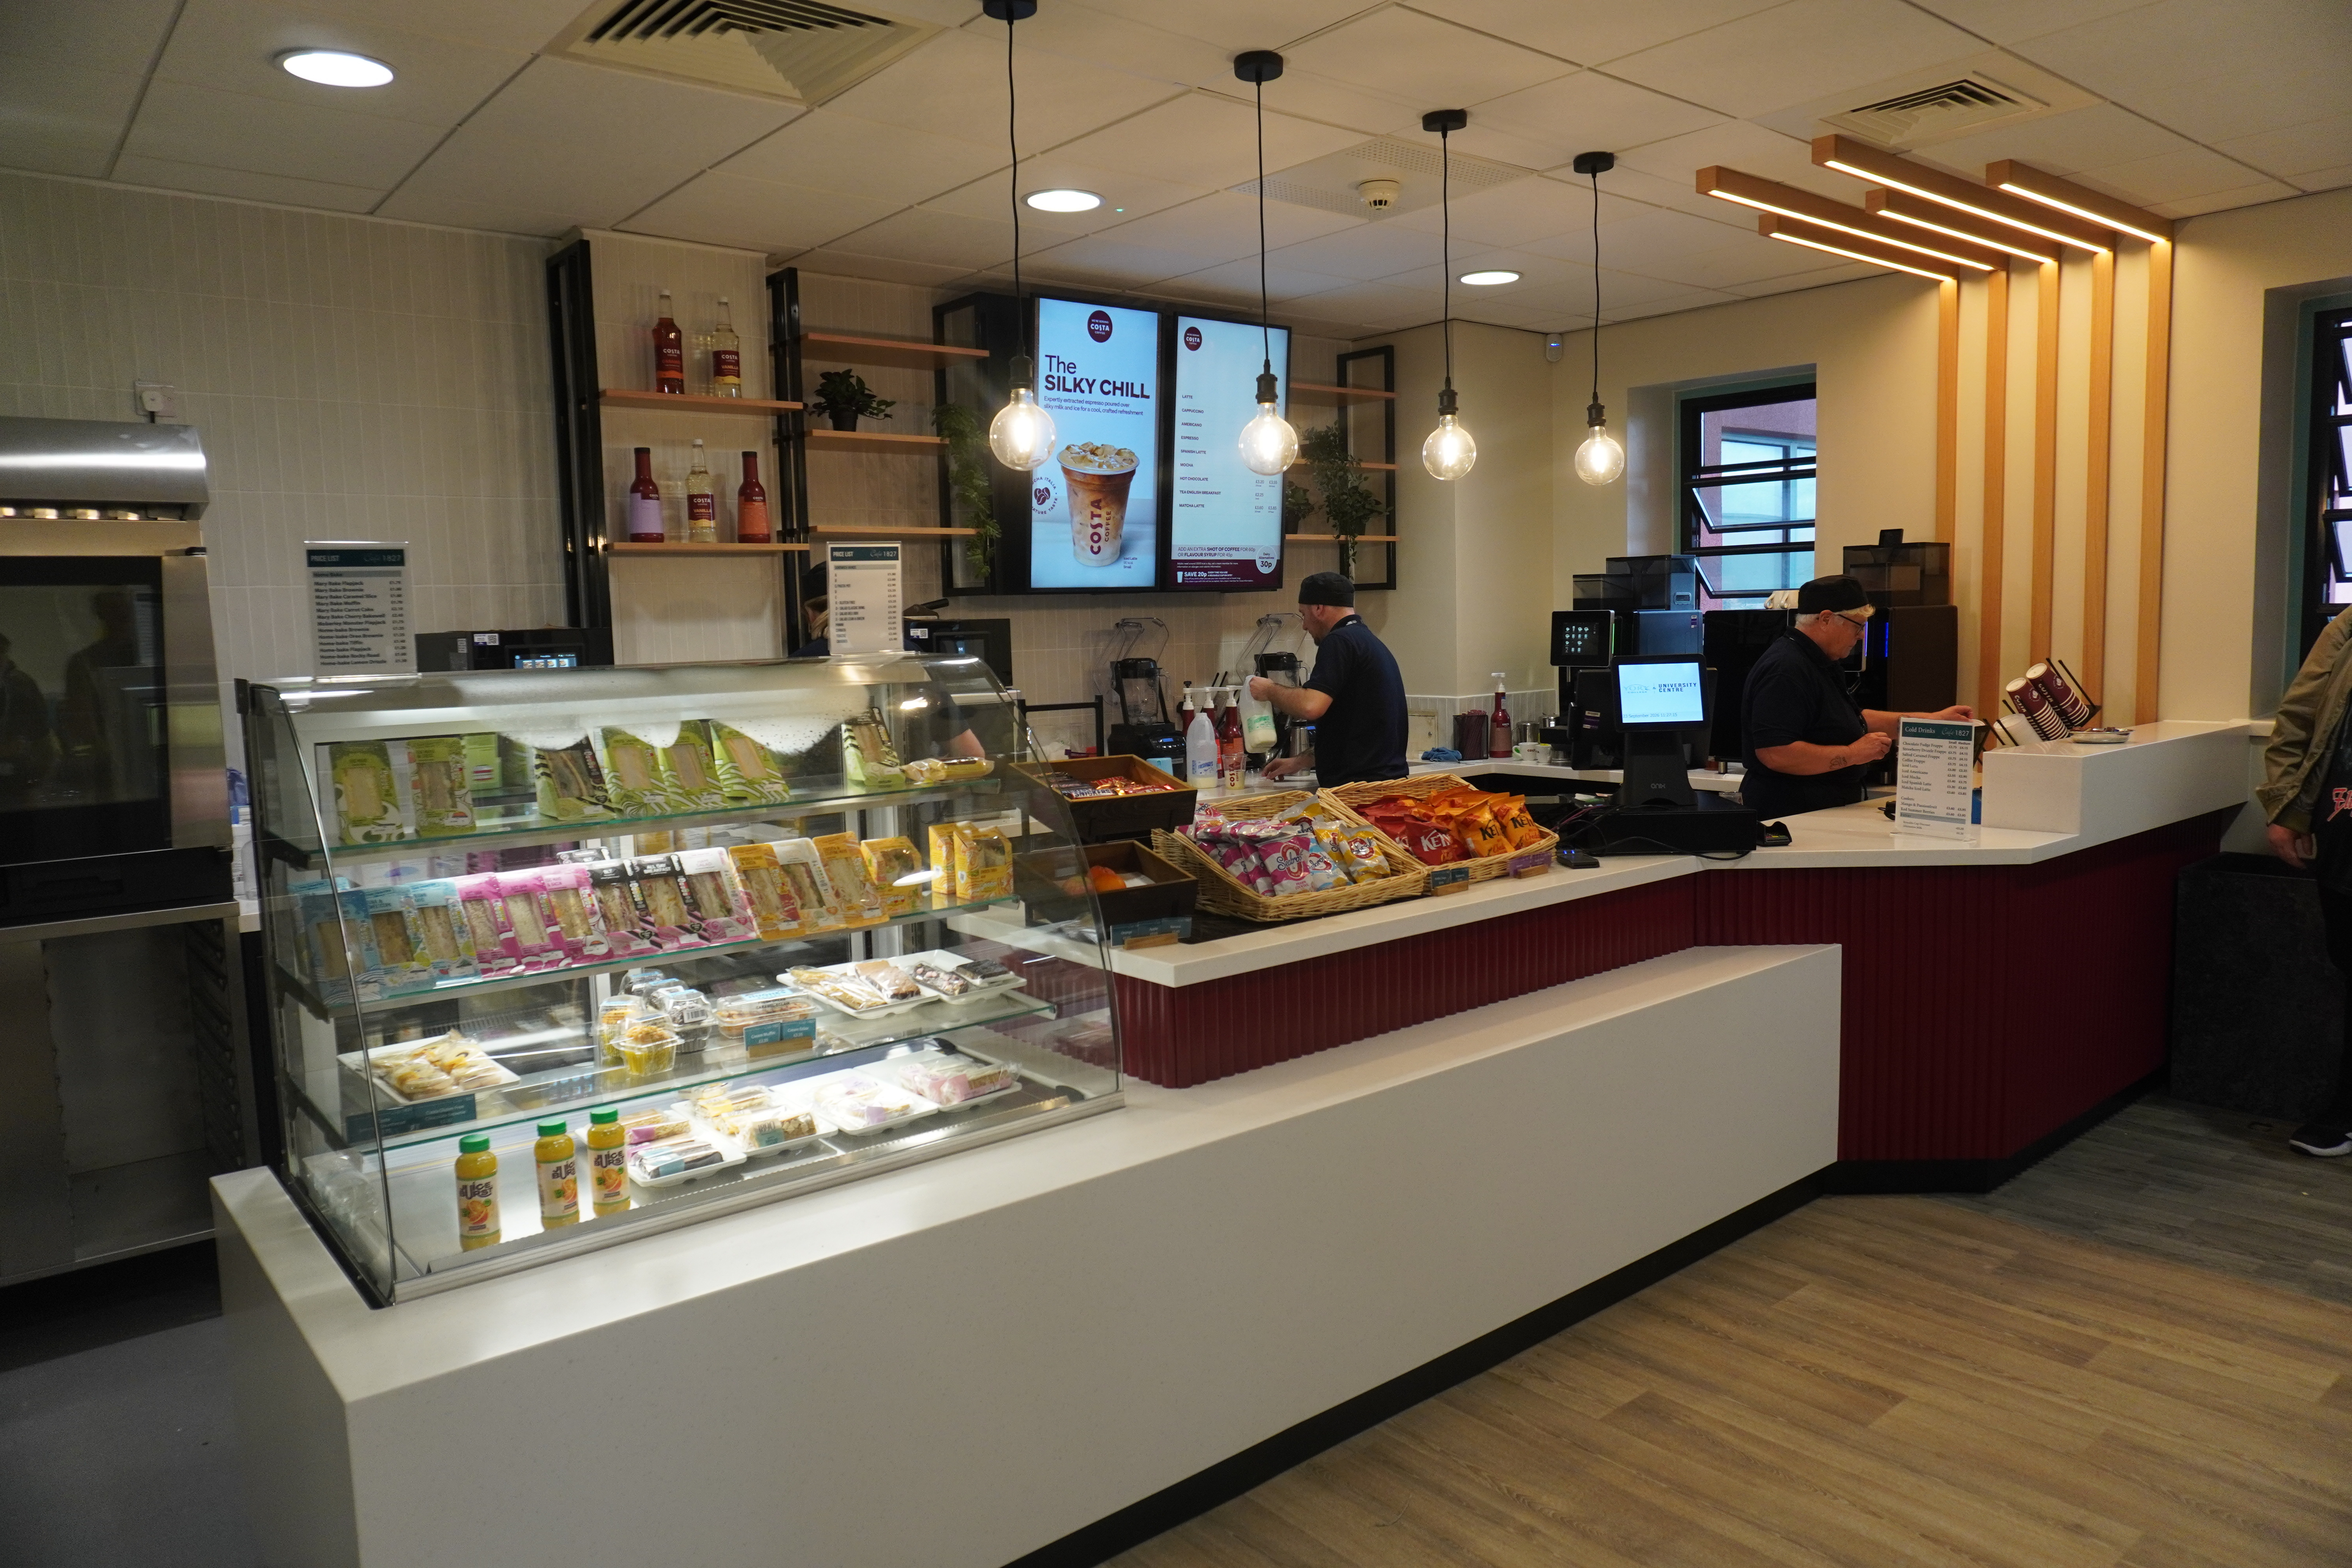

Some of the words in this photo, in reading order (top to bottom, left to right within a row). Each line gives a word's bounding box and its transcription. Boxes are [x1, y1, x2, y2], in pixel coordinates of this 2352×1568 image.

[1045, 354, 1076, 374] The
[1044, 374, 1096, 394] SILKY
[1100, 379, 1150, 399] CHILL
[1045, 477, 1056, 490] ITALIA
[1048, 497, 1057, 512] TASTE
[1090, 498, 1103, 555] COSTA
